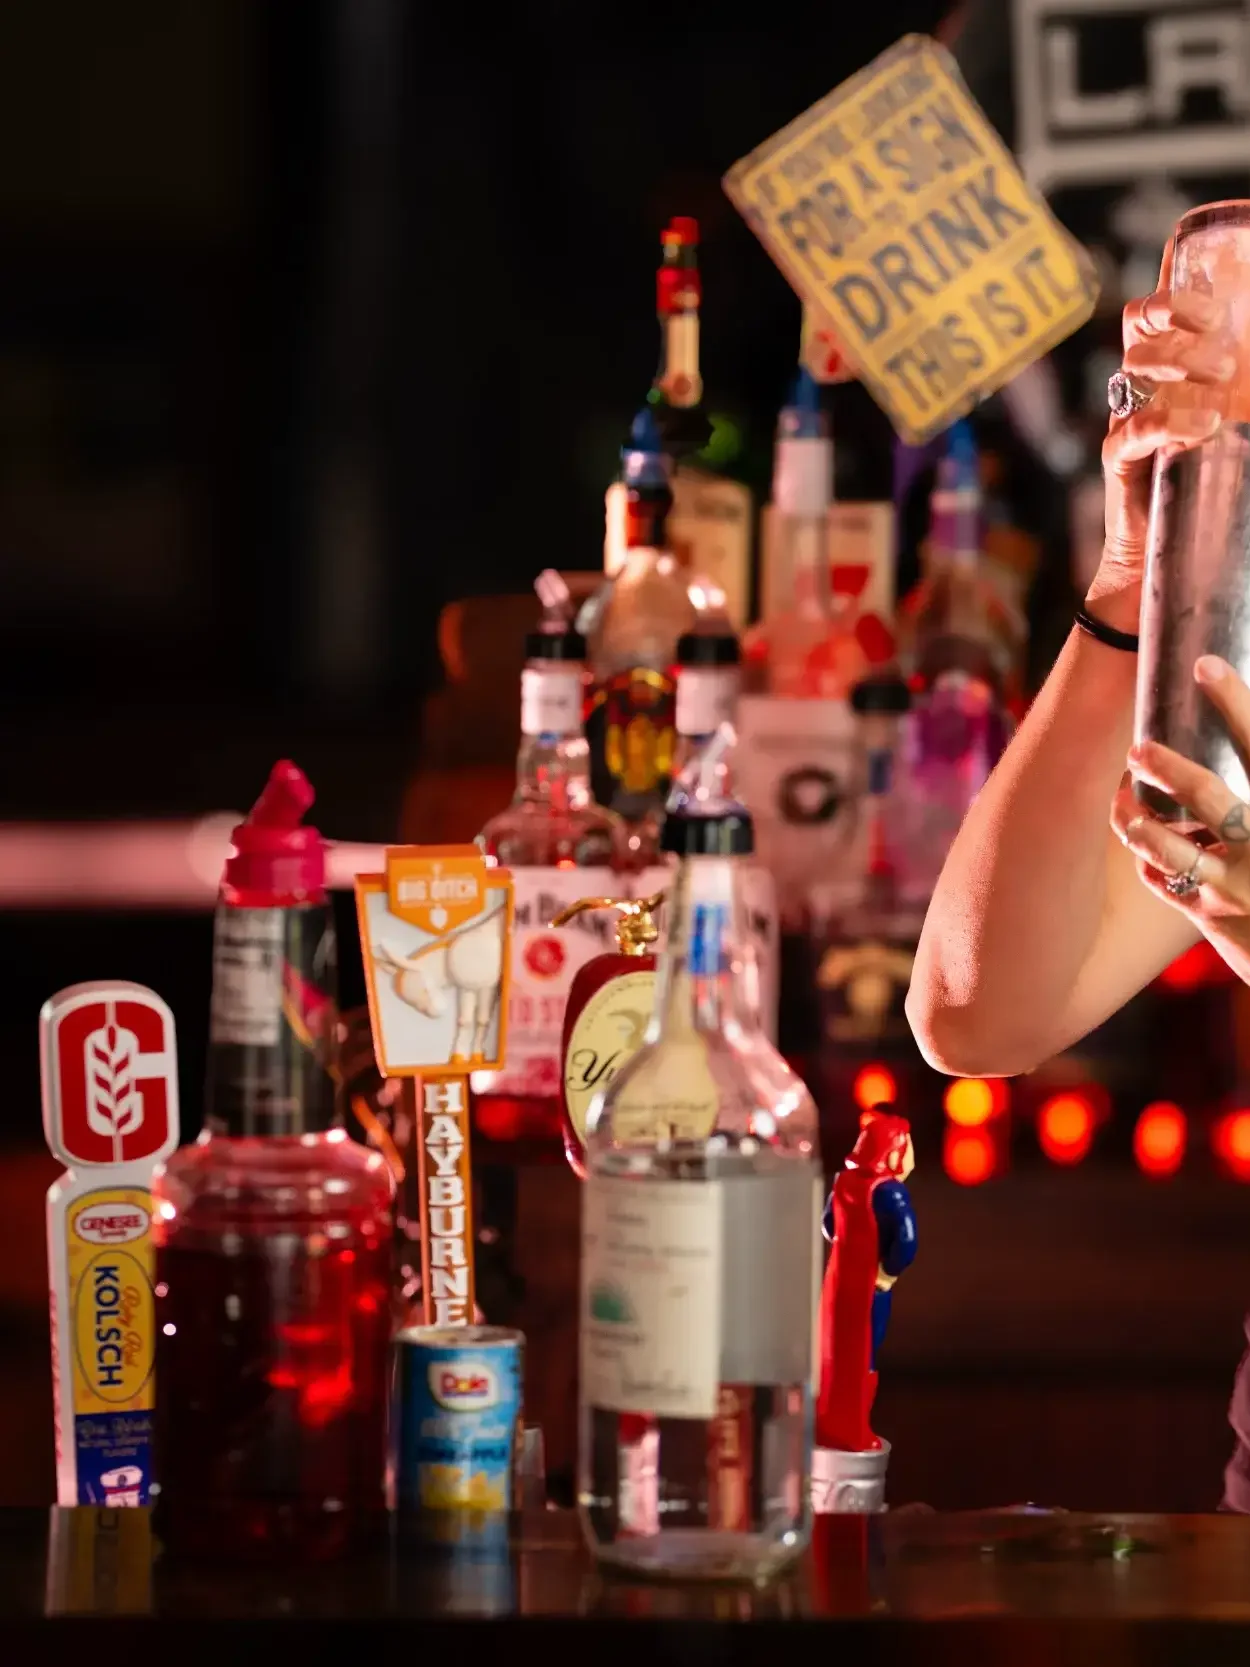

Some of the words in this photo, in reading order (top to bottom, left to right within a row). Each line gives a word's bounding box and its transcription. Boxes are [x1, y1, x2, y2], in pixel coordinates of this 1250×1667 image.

[1047, 18, 1250, 124] LA
[778, 179, 868, 280] FOR
[850, 161, 882, 195] A
[876, 92, 986, 195] SIGN
[829, 164, 1031, 345] DRINK
[883, 312, 987, 413] THIS
[967, 279, 1029, 350] IS
[424, 1082, 469, 1327] HAYBURNE
[94, 1266, 124, 1386] KOLSCH
